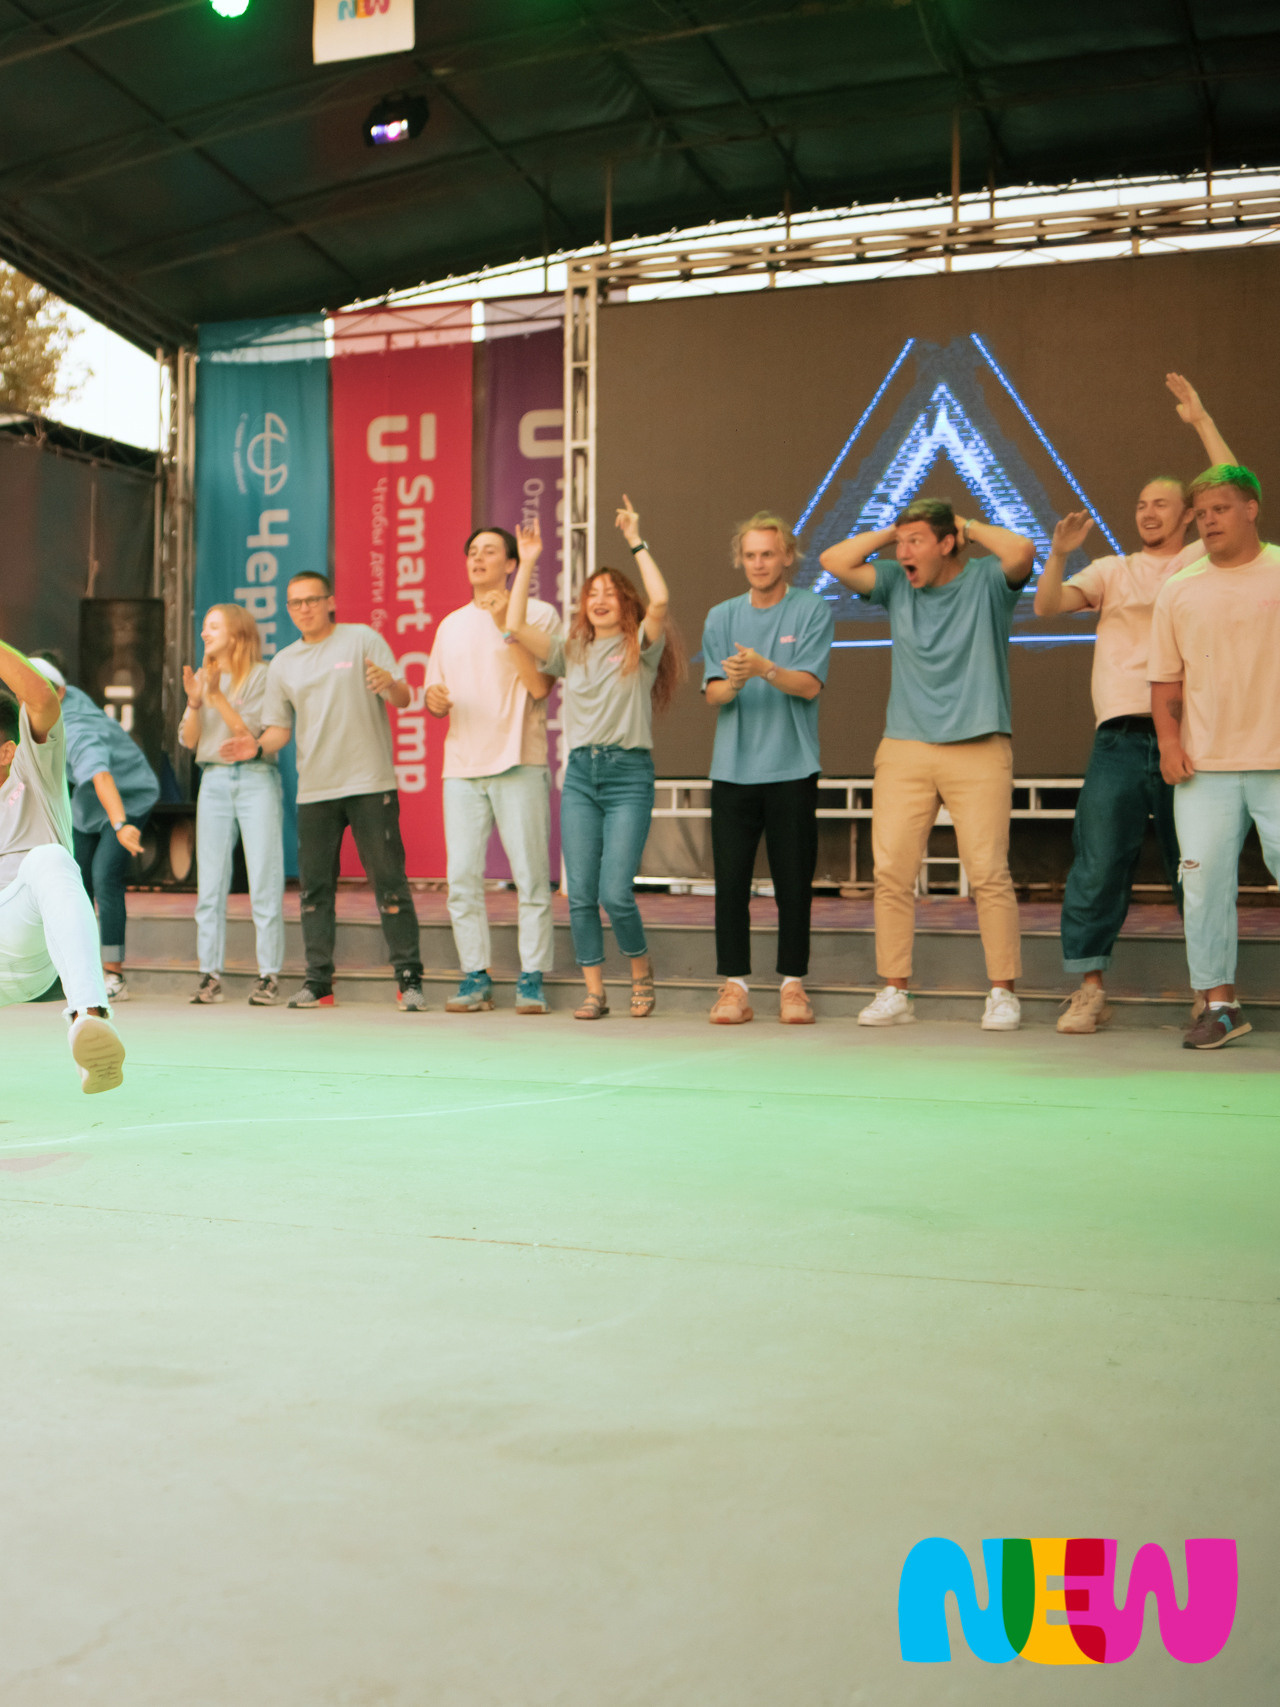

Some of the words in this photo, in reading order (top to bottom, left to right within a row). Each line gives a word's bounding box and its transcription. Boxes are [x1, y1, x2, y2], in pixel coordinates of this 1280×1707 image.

[234, 509, 289, 661] Черн
[396, 475, 434, 635] Smart
[395, 652, 431, 793] Camp
